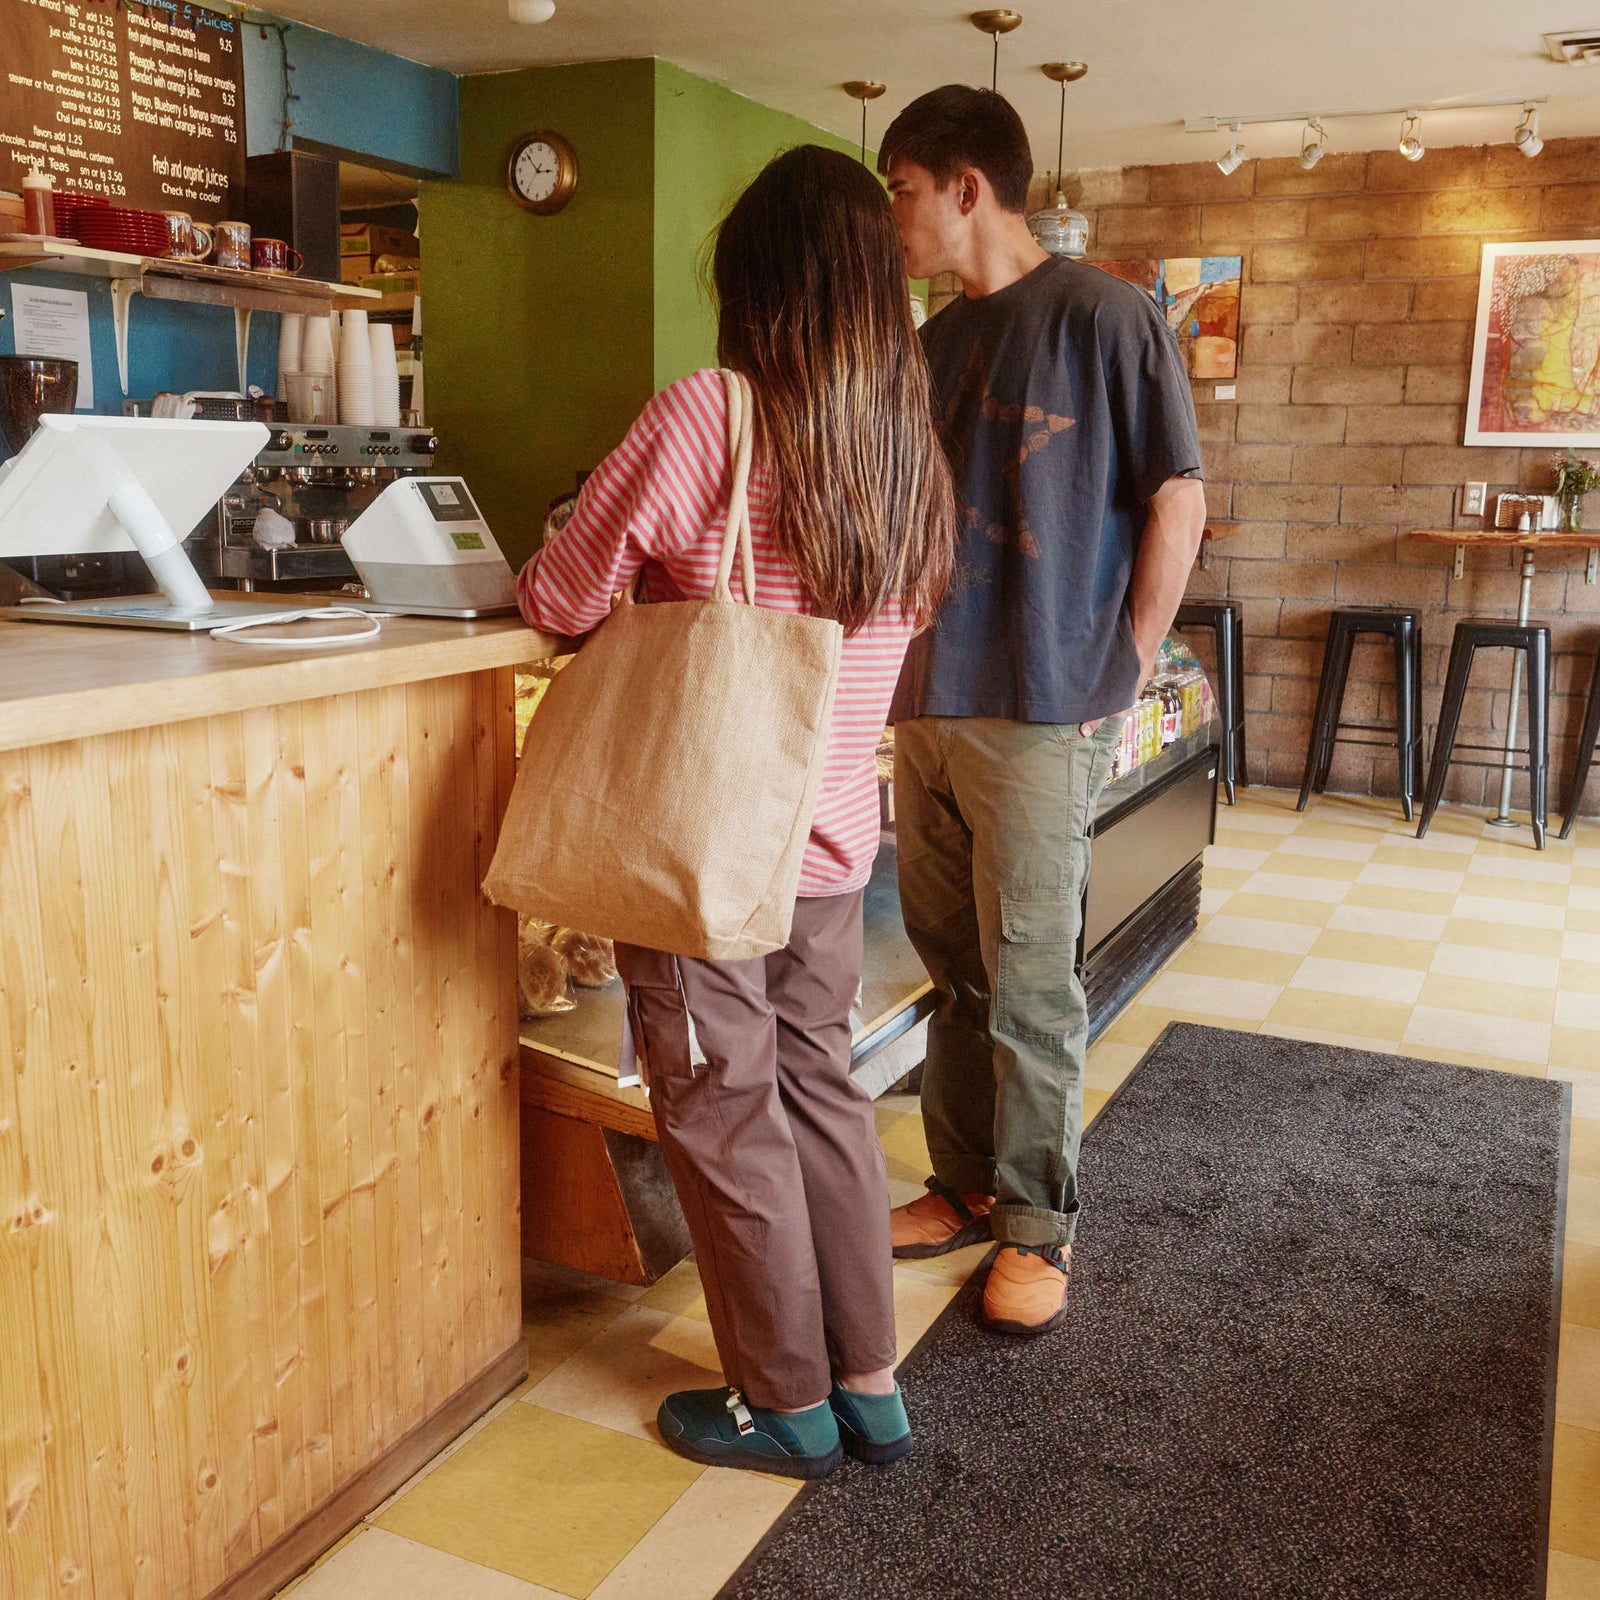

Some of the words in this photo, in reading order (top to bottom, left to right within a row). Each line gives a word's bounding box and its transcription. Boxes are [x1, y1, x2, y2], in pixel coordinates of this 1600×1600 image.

[69, 17, 76, 28] 12
[78, 22, 86, 31] oz
[87, 24, 95, 33] or
[97, 24, 105, 36] 16
[106, 30, 114, 39] oz
[99, 14, 114, 27] 1.25
[127, 10, 151, 28] Famous
[151, 17, 169, 34] Green
[219, 37, 233, 53] 9.25
[197, 8, 235, 33] Juices
[49, 25, 61, 38] just
[62, 30, 81, 43] coffee
[83, 35, 117, 53] 2.50/3.50
[62, 45, 83, 57] mocha
[84, 49, 118, 67] 4.75/5.25
[51, 69, 84, 85] americano
[86, 75, 120, 93] 3.00/3.50
[85, 63, 119, 80] 4.25/5.00
[158, 59, 187, 83] Strawberry
[193, 69, 213, 87] Banana
[213, 77, 236, 93] smoothie
[34, 80, 42, 89] or
[43, 80, 54, 92] hot
[56, 84, 86, 100] chocolate
[87, 91, 121, 108] 4.25/4.50
[130, 67, 153, 86] Blended
[153, 75, 166, 89] with
[166, 80, 186, 97] orange
[222, 92, 236, 107] 9.25
[61, 100, 78, 111] extra
[78, 102, 92, 114] shot
[93, 107, 105, 117] add
[107, 108, 121, 121] 1.75
[153, 96, 182, 118] Blueberry
[188, 105, 209, 122] Banana
[209, 113, 235, 128] smoothie
[56, 111, 71, 124] Chai
[88, 118, 122, 135] 5.00/5.25
[132, 106, 158, 125] Blended
[158, 114, 174, 128] with
[174, 119, 197, 136] orange
[224, 128, 238, 143] 9.25
[33, 125, 53, 139] flavors
[54, 132, 66, 143] add
[68, 132, 83, 146] 1.25
[11, 149, 45, 168] Herbal
[48, 157, 70, 173] Teas
[80, 166, 90, 176] sm
[91, 169, 99, 178] or
[100, 168, 106, 182] lg
[107, 169, 123, 183] 3.50
[170, 159, 182, 179] and
[182, 163, 205, 187] organic
[204, 167, 229, 190] juices
[65, 177, 76, 187] sm
[77, 177, 94, 190] 4.50
[94, 183, 102, 192] or
[103, 182, 110, 196] lg
[111, 183, 126, 196] 5.50
[161, 182, 184, 198] Check
[185, 188, 198, 200] the
[199, 192, 222, 204] cooler
